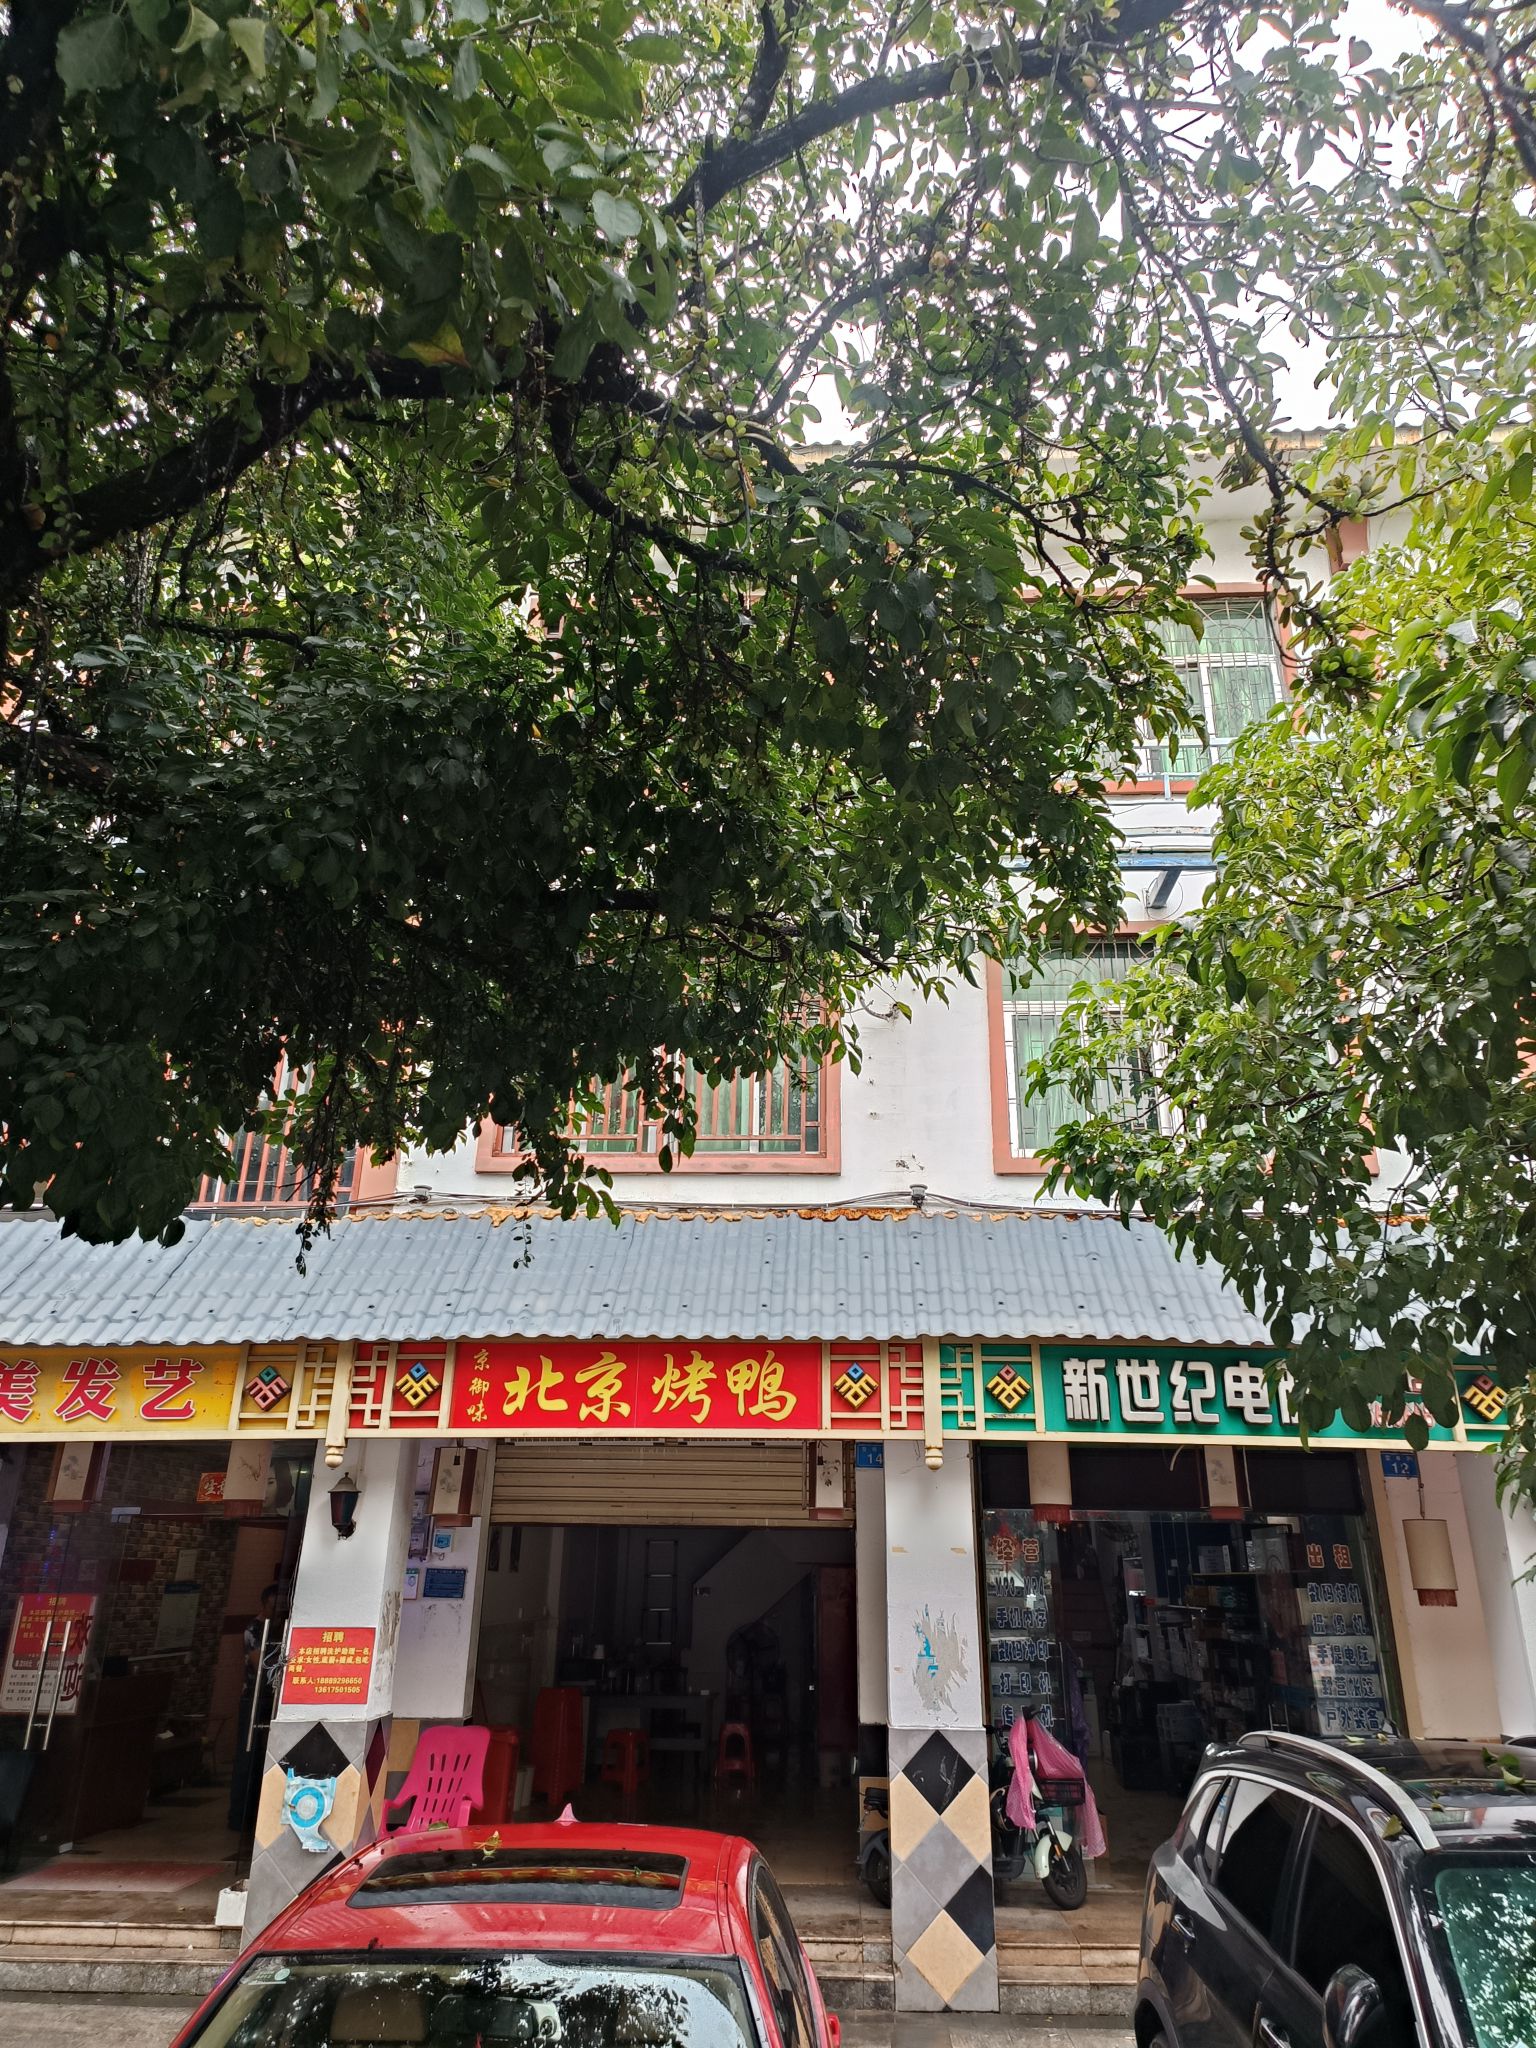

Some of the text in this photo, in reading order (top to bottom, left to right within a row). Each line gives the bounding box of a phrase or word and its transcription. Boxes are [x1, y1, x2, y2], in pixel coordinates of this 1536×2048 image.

[0, 1357, 205, 1423] 美发艺
[466, 1348, 490, 1423] 京御味
[502, 1350, 798, 1425] 北京烤鸭
[1391, 1461, 1410, 1475] 12
[996, 1537, 1040, 1563] 经营
[1306, 1543, 1353, 1569] 出租
[1307, 1582, 1363, 1605] 数码相机
[996, 1606, 1048, 1629] 手机内存
[1312, 1612, 1367, 1635] 摄像机
[321, 1630, 345, 1643] 招聘
[998, 1639, 1049, 1661] 数码冲印
[1316, 1644, 1370, 1667] 手提电脑
[1000, 1672, 1052, 1694] 打印机
[1002, 1703, 1054, 1728] 传机
[1325, 1706, 1381, 1731] 户外装备
